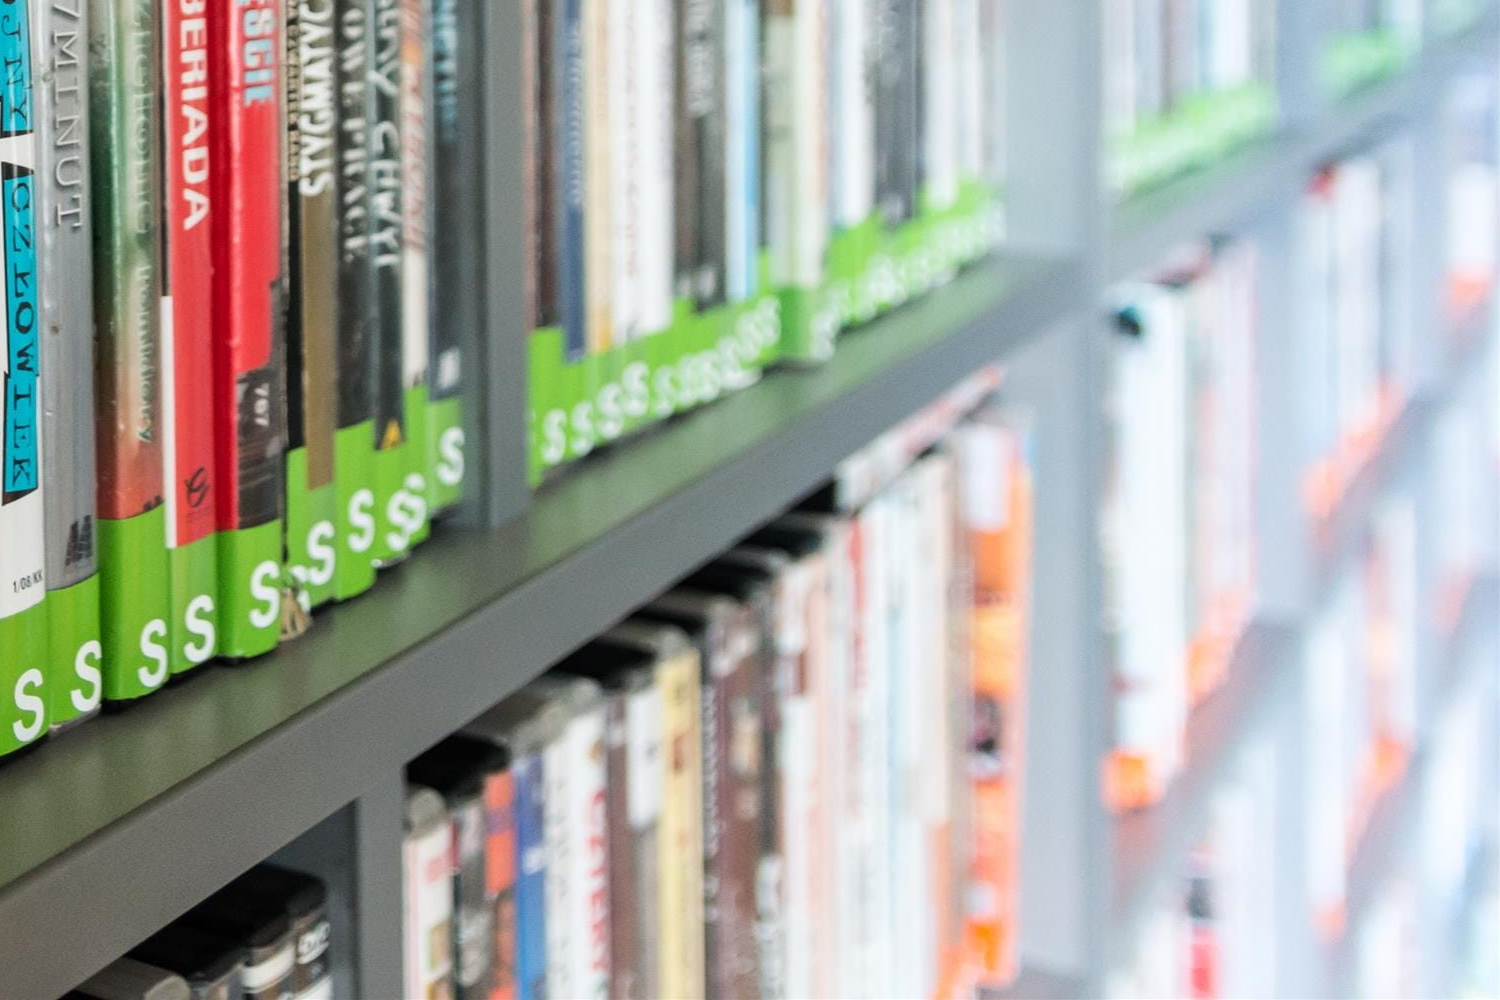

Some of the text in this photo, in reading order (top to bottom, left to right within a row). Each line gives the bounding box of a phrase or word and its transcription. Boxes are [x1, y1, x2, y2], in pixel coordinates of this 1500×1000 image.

[10, 181, 36, 489] CZŁOWIEK
[436, 426, 465, 486] S
[307, 520, 336, 587] S
[347, 488, 375, 553] S
[183, 594, 215, 663] S
[249, 560, 281, 629] S
[70, 639, 103, 713] S
[137, 618, 168, 694] S
[11, 667, 45, 742] S
